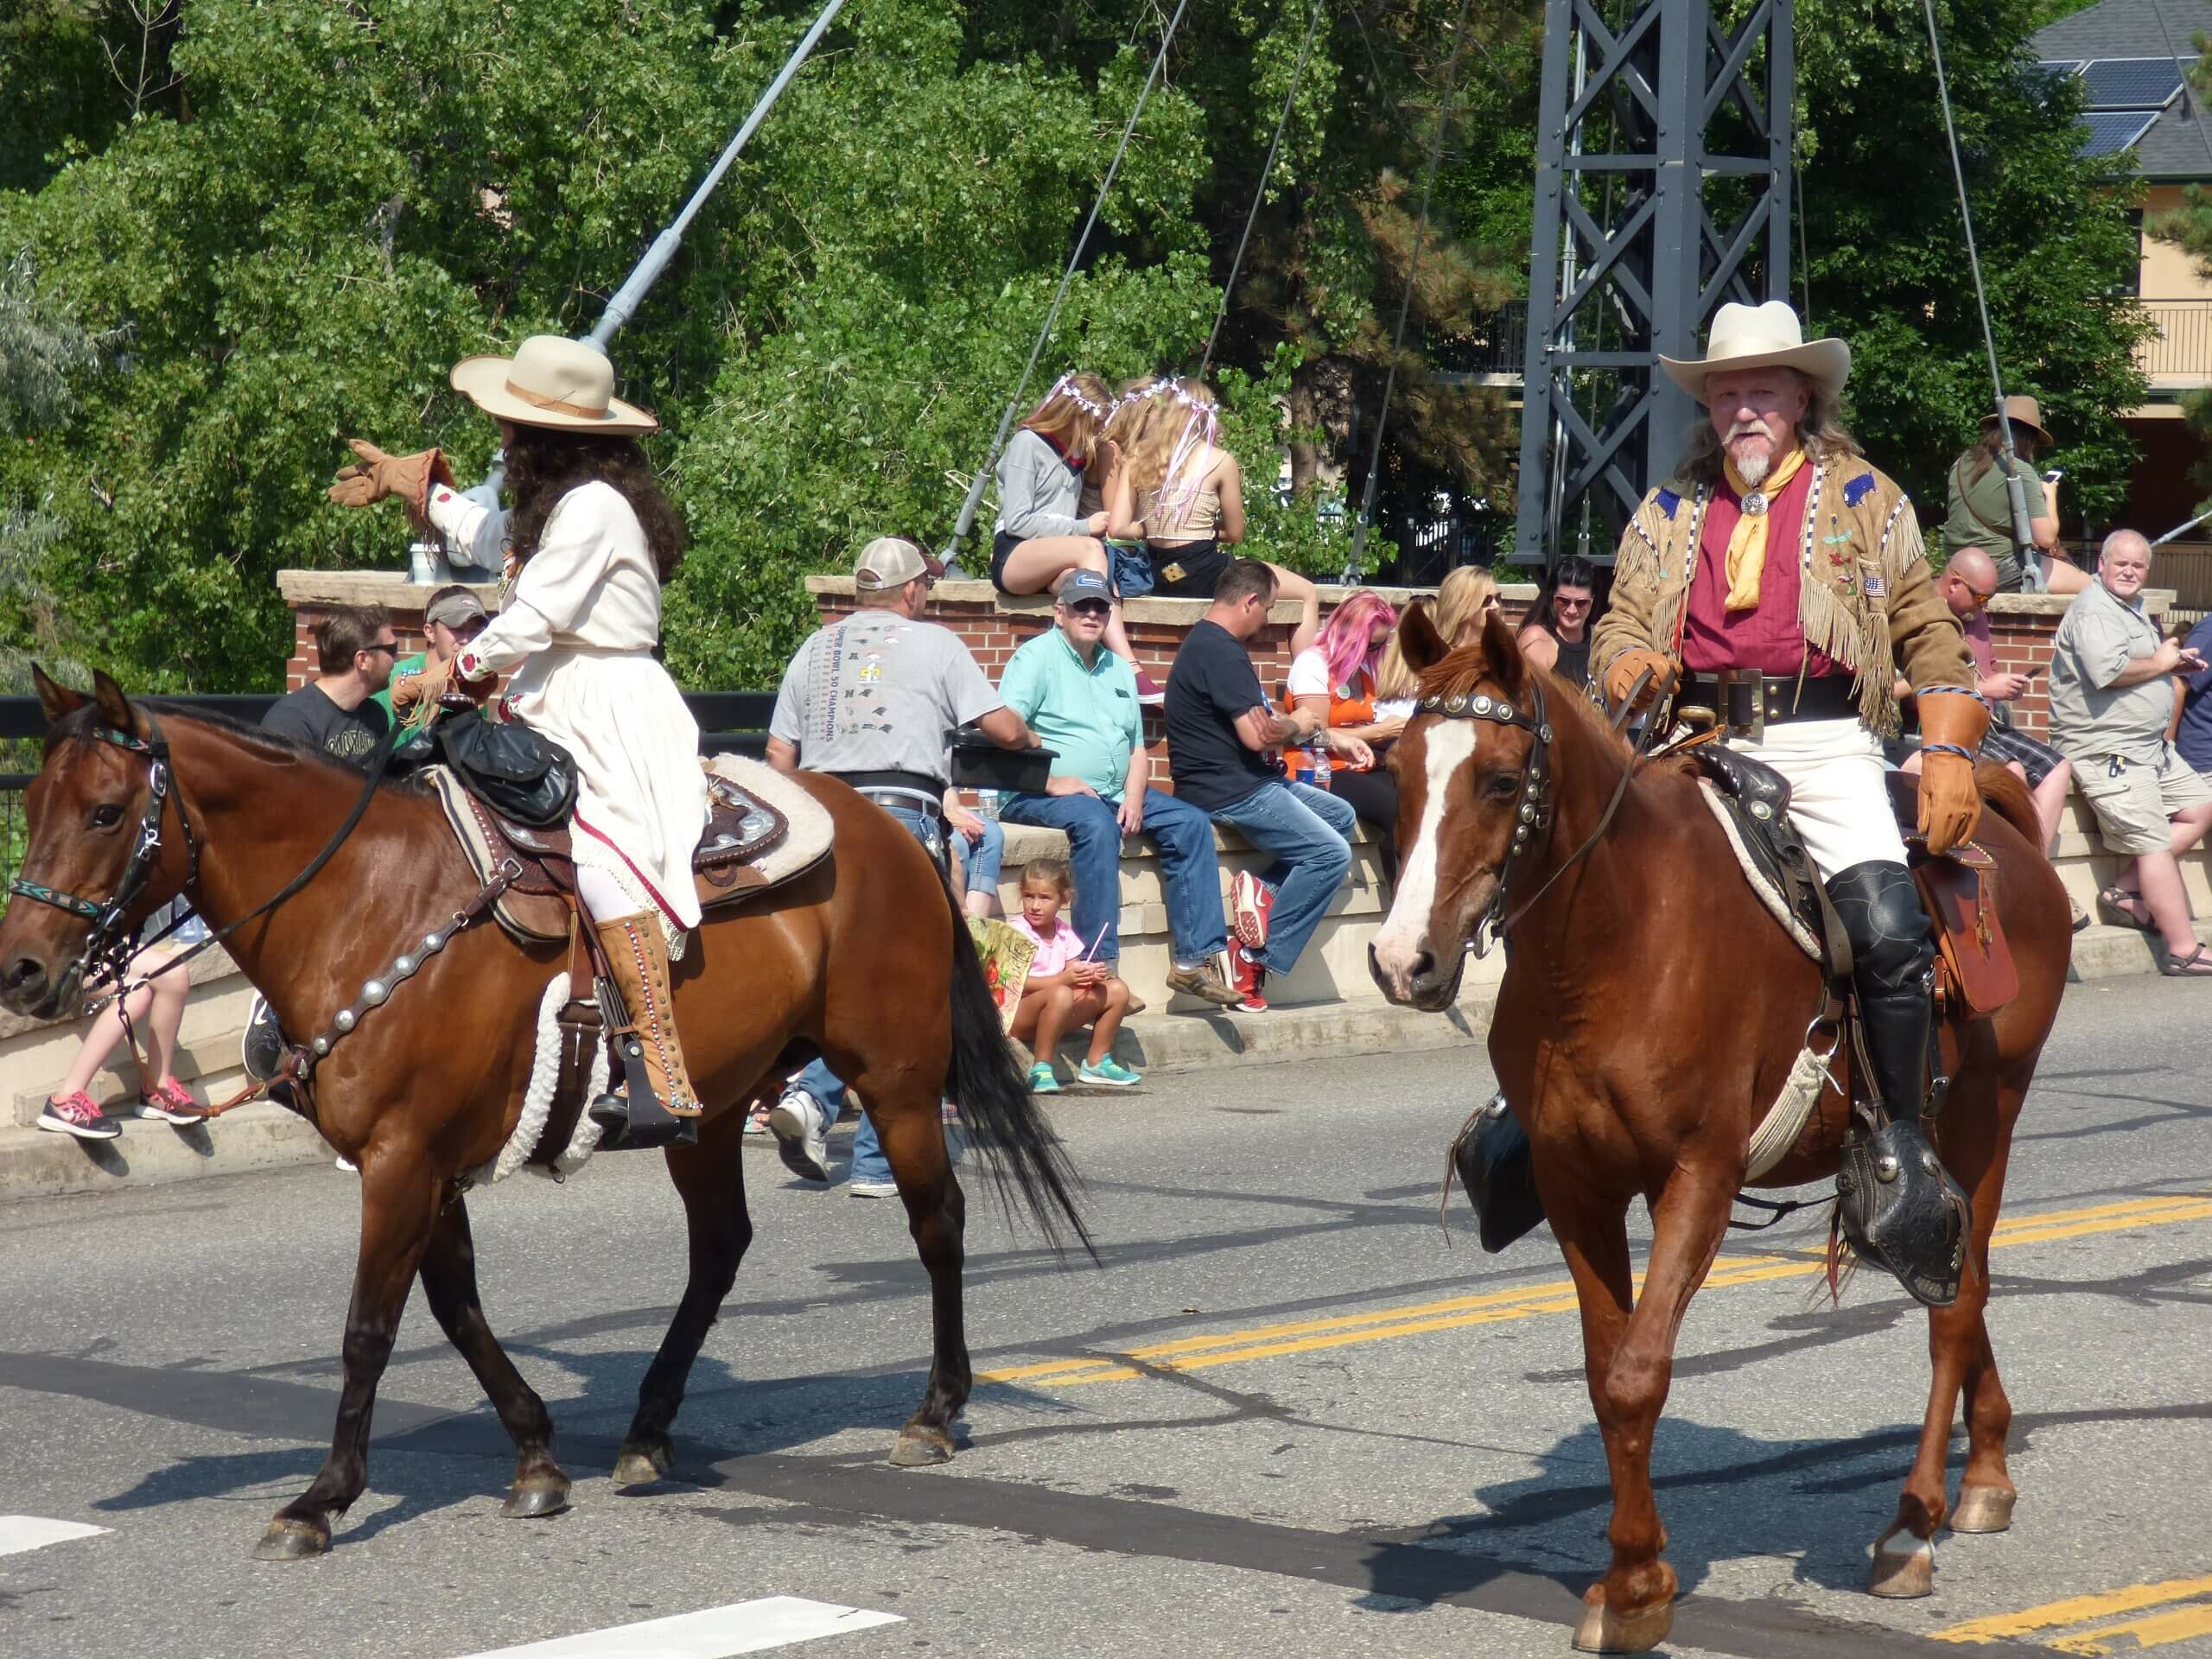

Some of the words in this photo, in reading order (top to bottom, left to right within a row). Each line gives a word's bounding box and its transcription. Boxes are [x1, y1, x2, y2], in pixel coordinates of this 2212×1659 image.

[832, 651, 842, 673] BOWL
[830, 676, 839, 688] 50
[826, 690, 838, 742] CHAMPIONS
